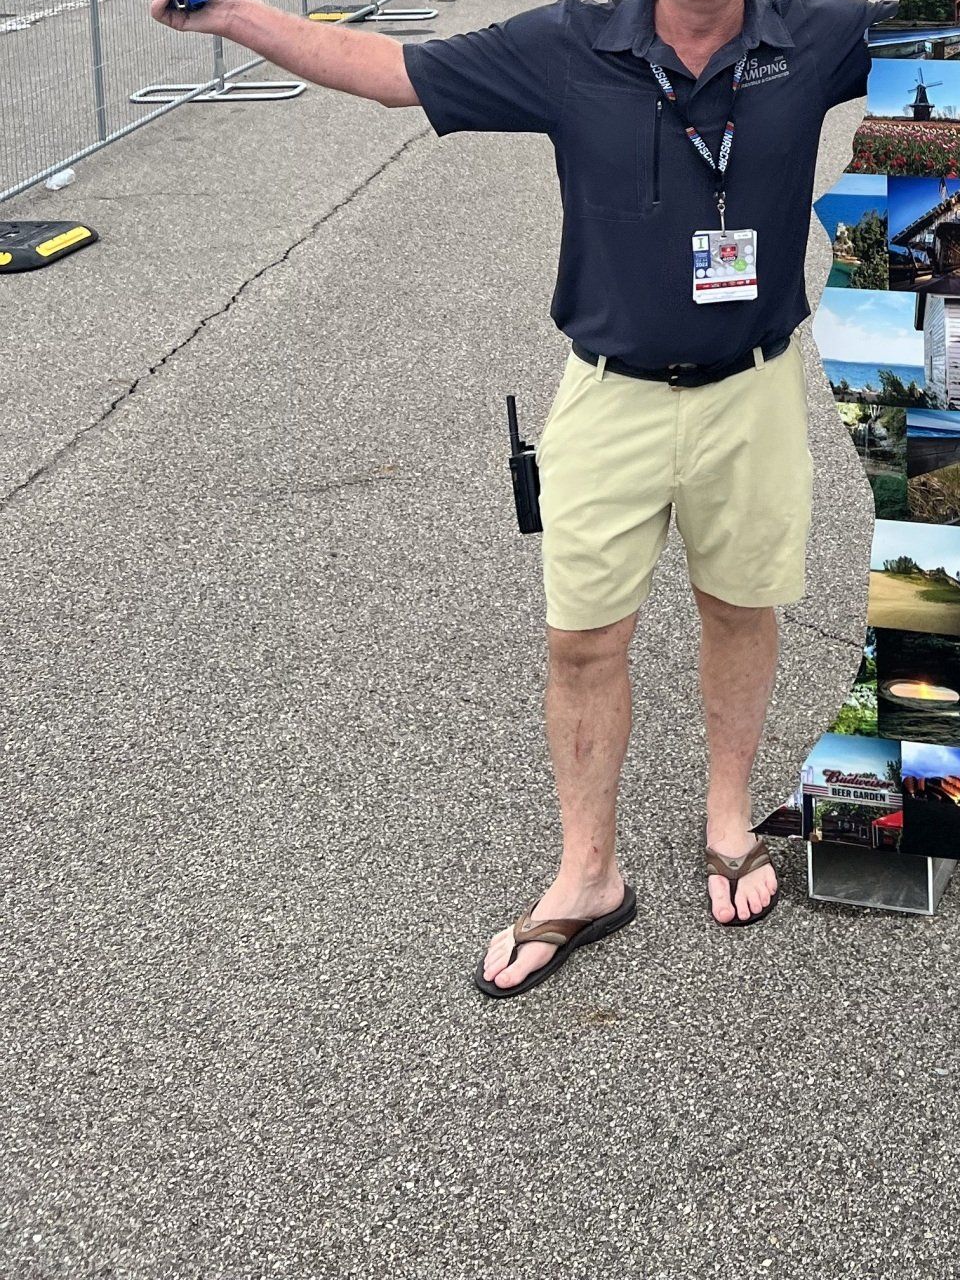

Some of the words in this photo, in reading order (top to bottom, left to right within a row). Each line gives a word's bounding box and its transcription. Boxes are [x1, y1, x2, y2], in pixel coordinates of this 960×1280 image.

[717, 132, 734, 172] NASCAR
[822, 769, 895, 789] Budweiser
[831, 787, 852, 798] BEER
[853, 790, 886, 802] GARDEN
